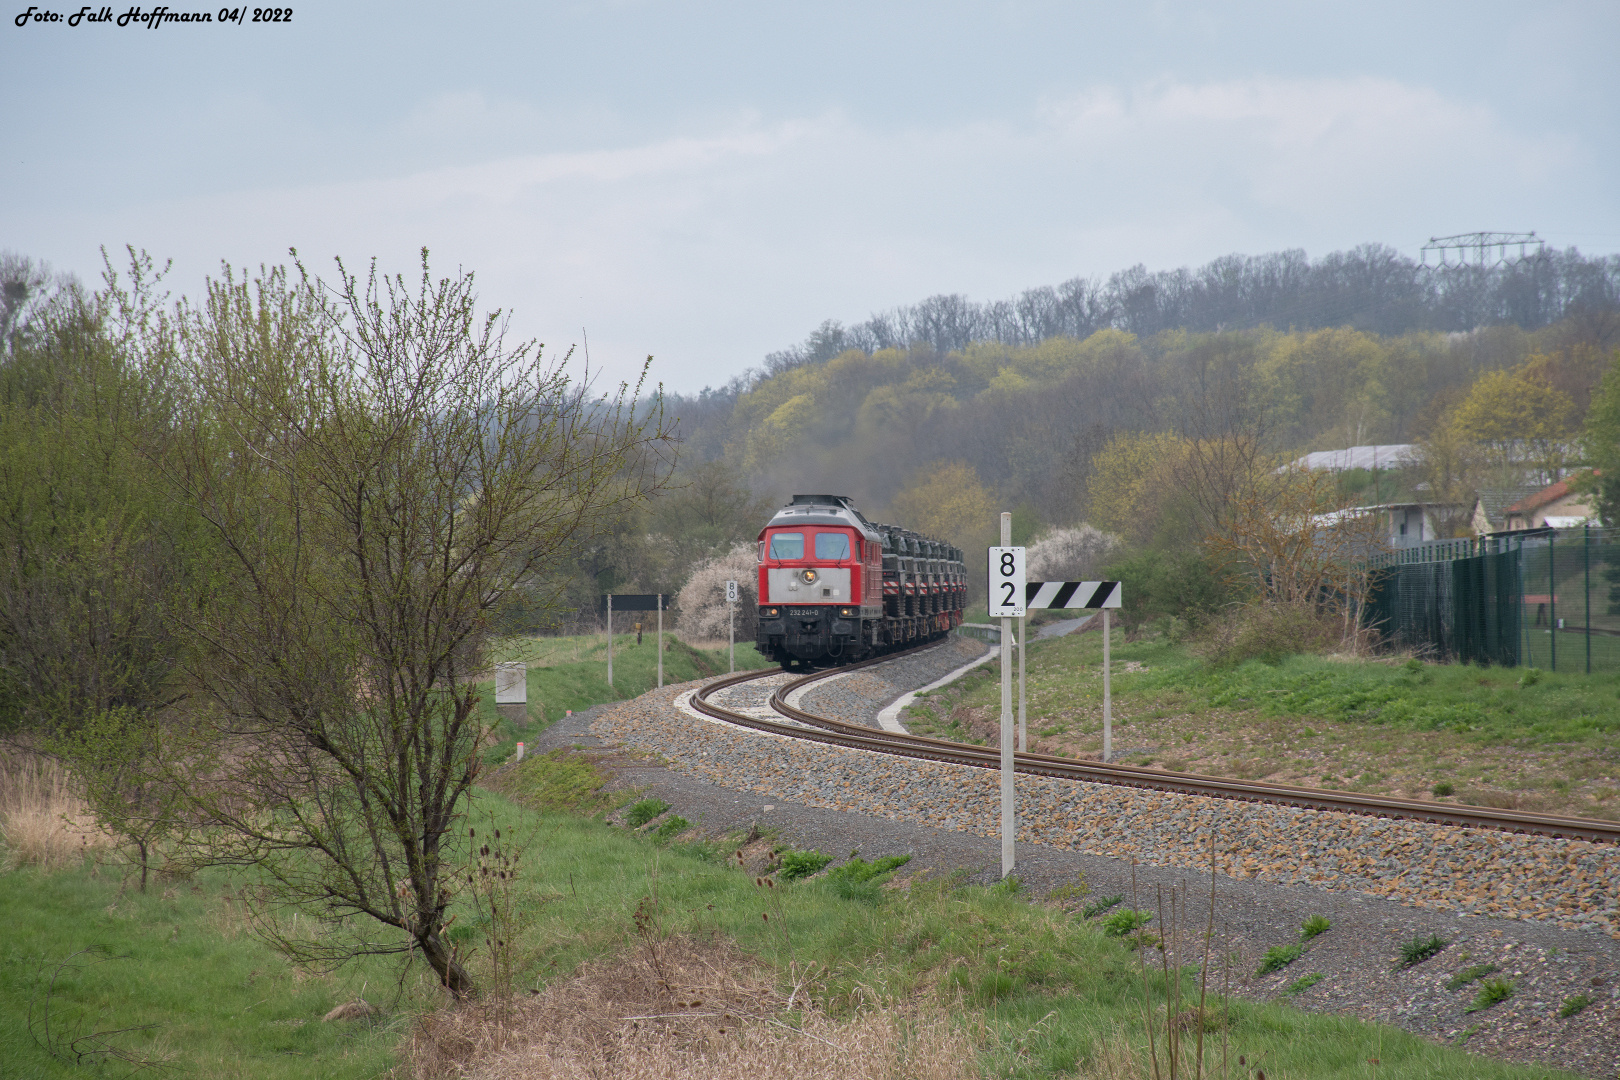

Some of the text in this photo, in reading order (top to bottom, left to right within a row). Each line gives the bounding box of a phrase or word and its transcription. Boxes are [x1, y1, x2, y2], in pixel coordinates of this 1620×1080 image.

[1000, 552, 1016, 577] 8
[729, 582, 735, 590] 8
[1000, 581, 1016, 607] 2
